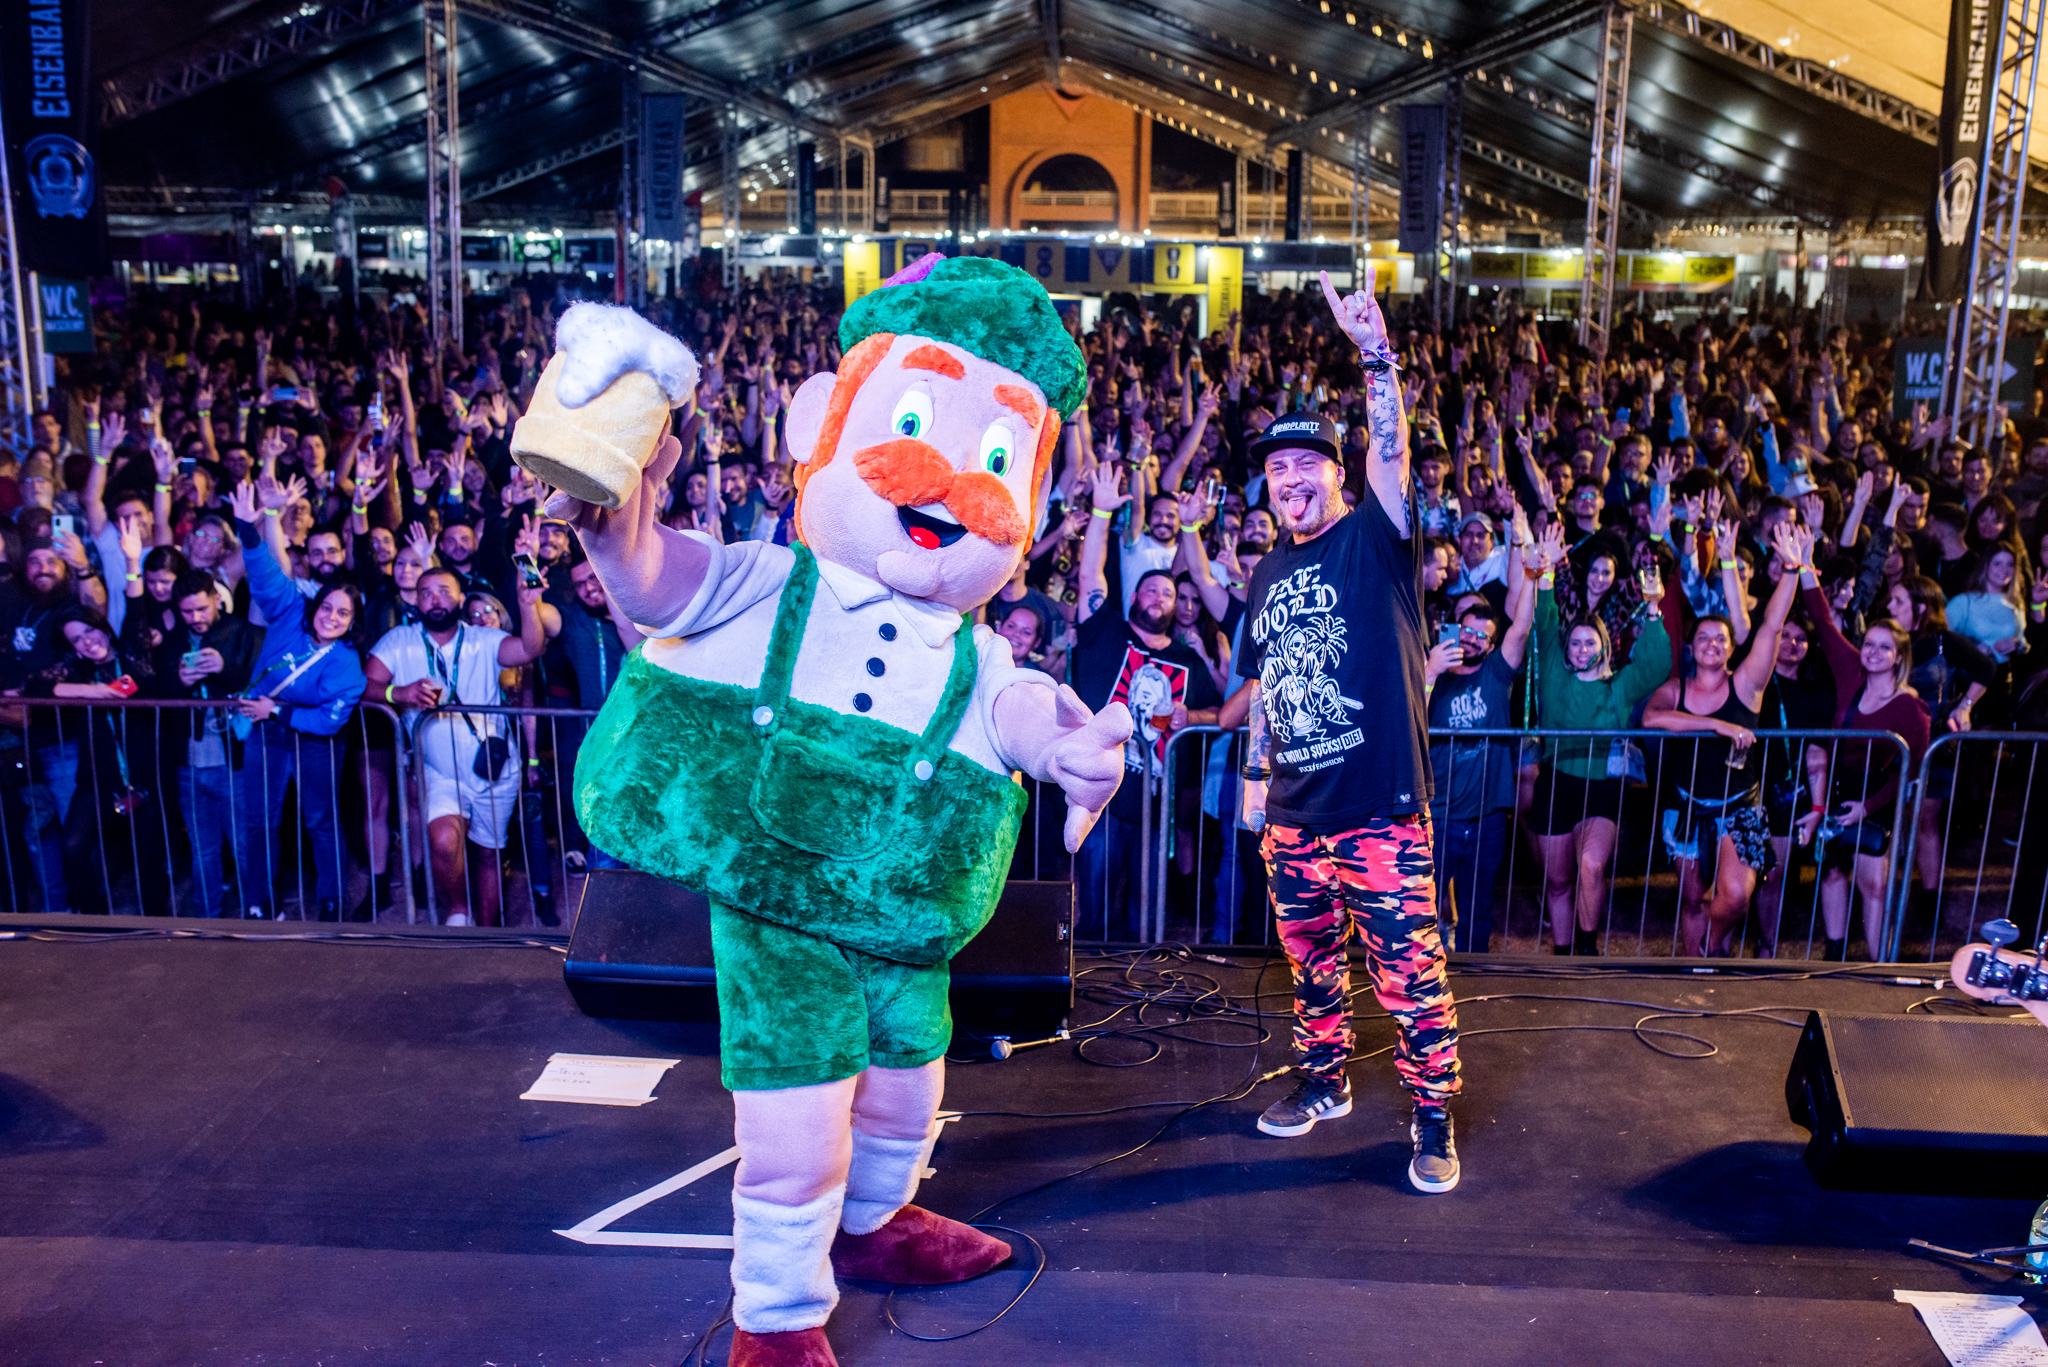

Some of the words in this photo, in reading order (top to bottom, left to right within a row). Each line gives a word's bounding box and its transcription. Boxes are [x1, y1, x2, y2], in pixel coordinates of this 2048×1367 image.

[41, 285, 84, 319] W.C.
[1283, 746, 1310, 764] WORLD
[1309, 737, 1343, 759] SUCKS!
[1342, 729, 1362, 748] DIE!
[1315, 756, 1345, 771] FASHION
